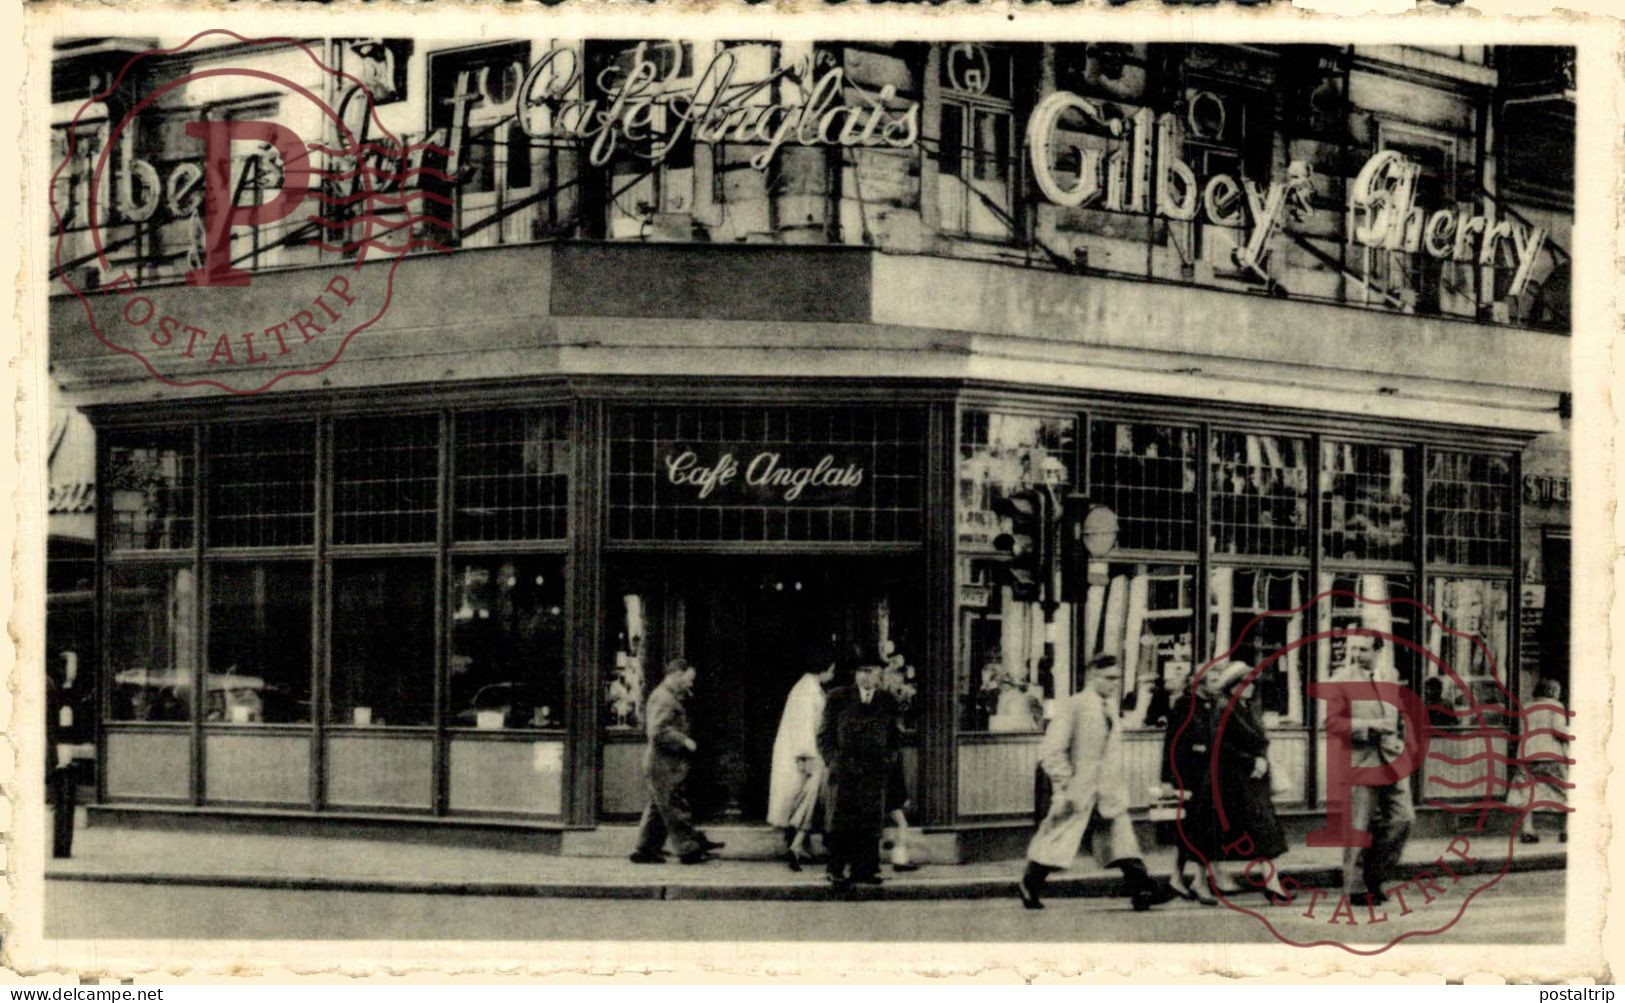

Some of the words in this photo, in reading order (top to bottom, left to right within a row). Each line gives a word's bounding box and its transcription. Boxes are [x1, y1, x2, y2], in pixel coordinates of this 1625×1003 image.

[1350, 150, 1549, 297] Sherry
[665, 451, 738, 499] Café
[745, 452, 864, 501] Anglais
